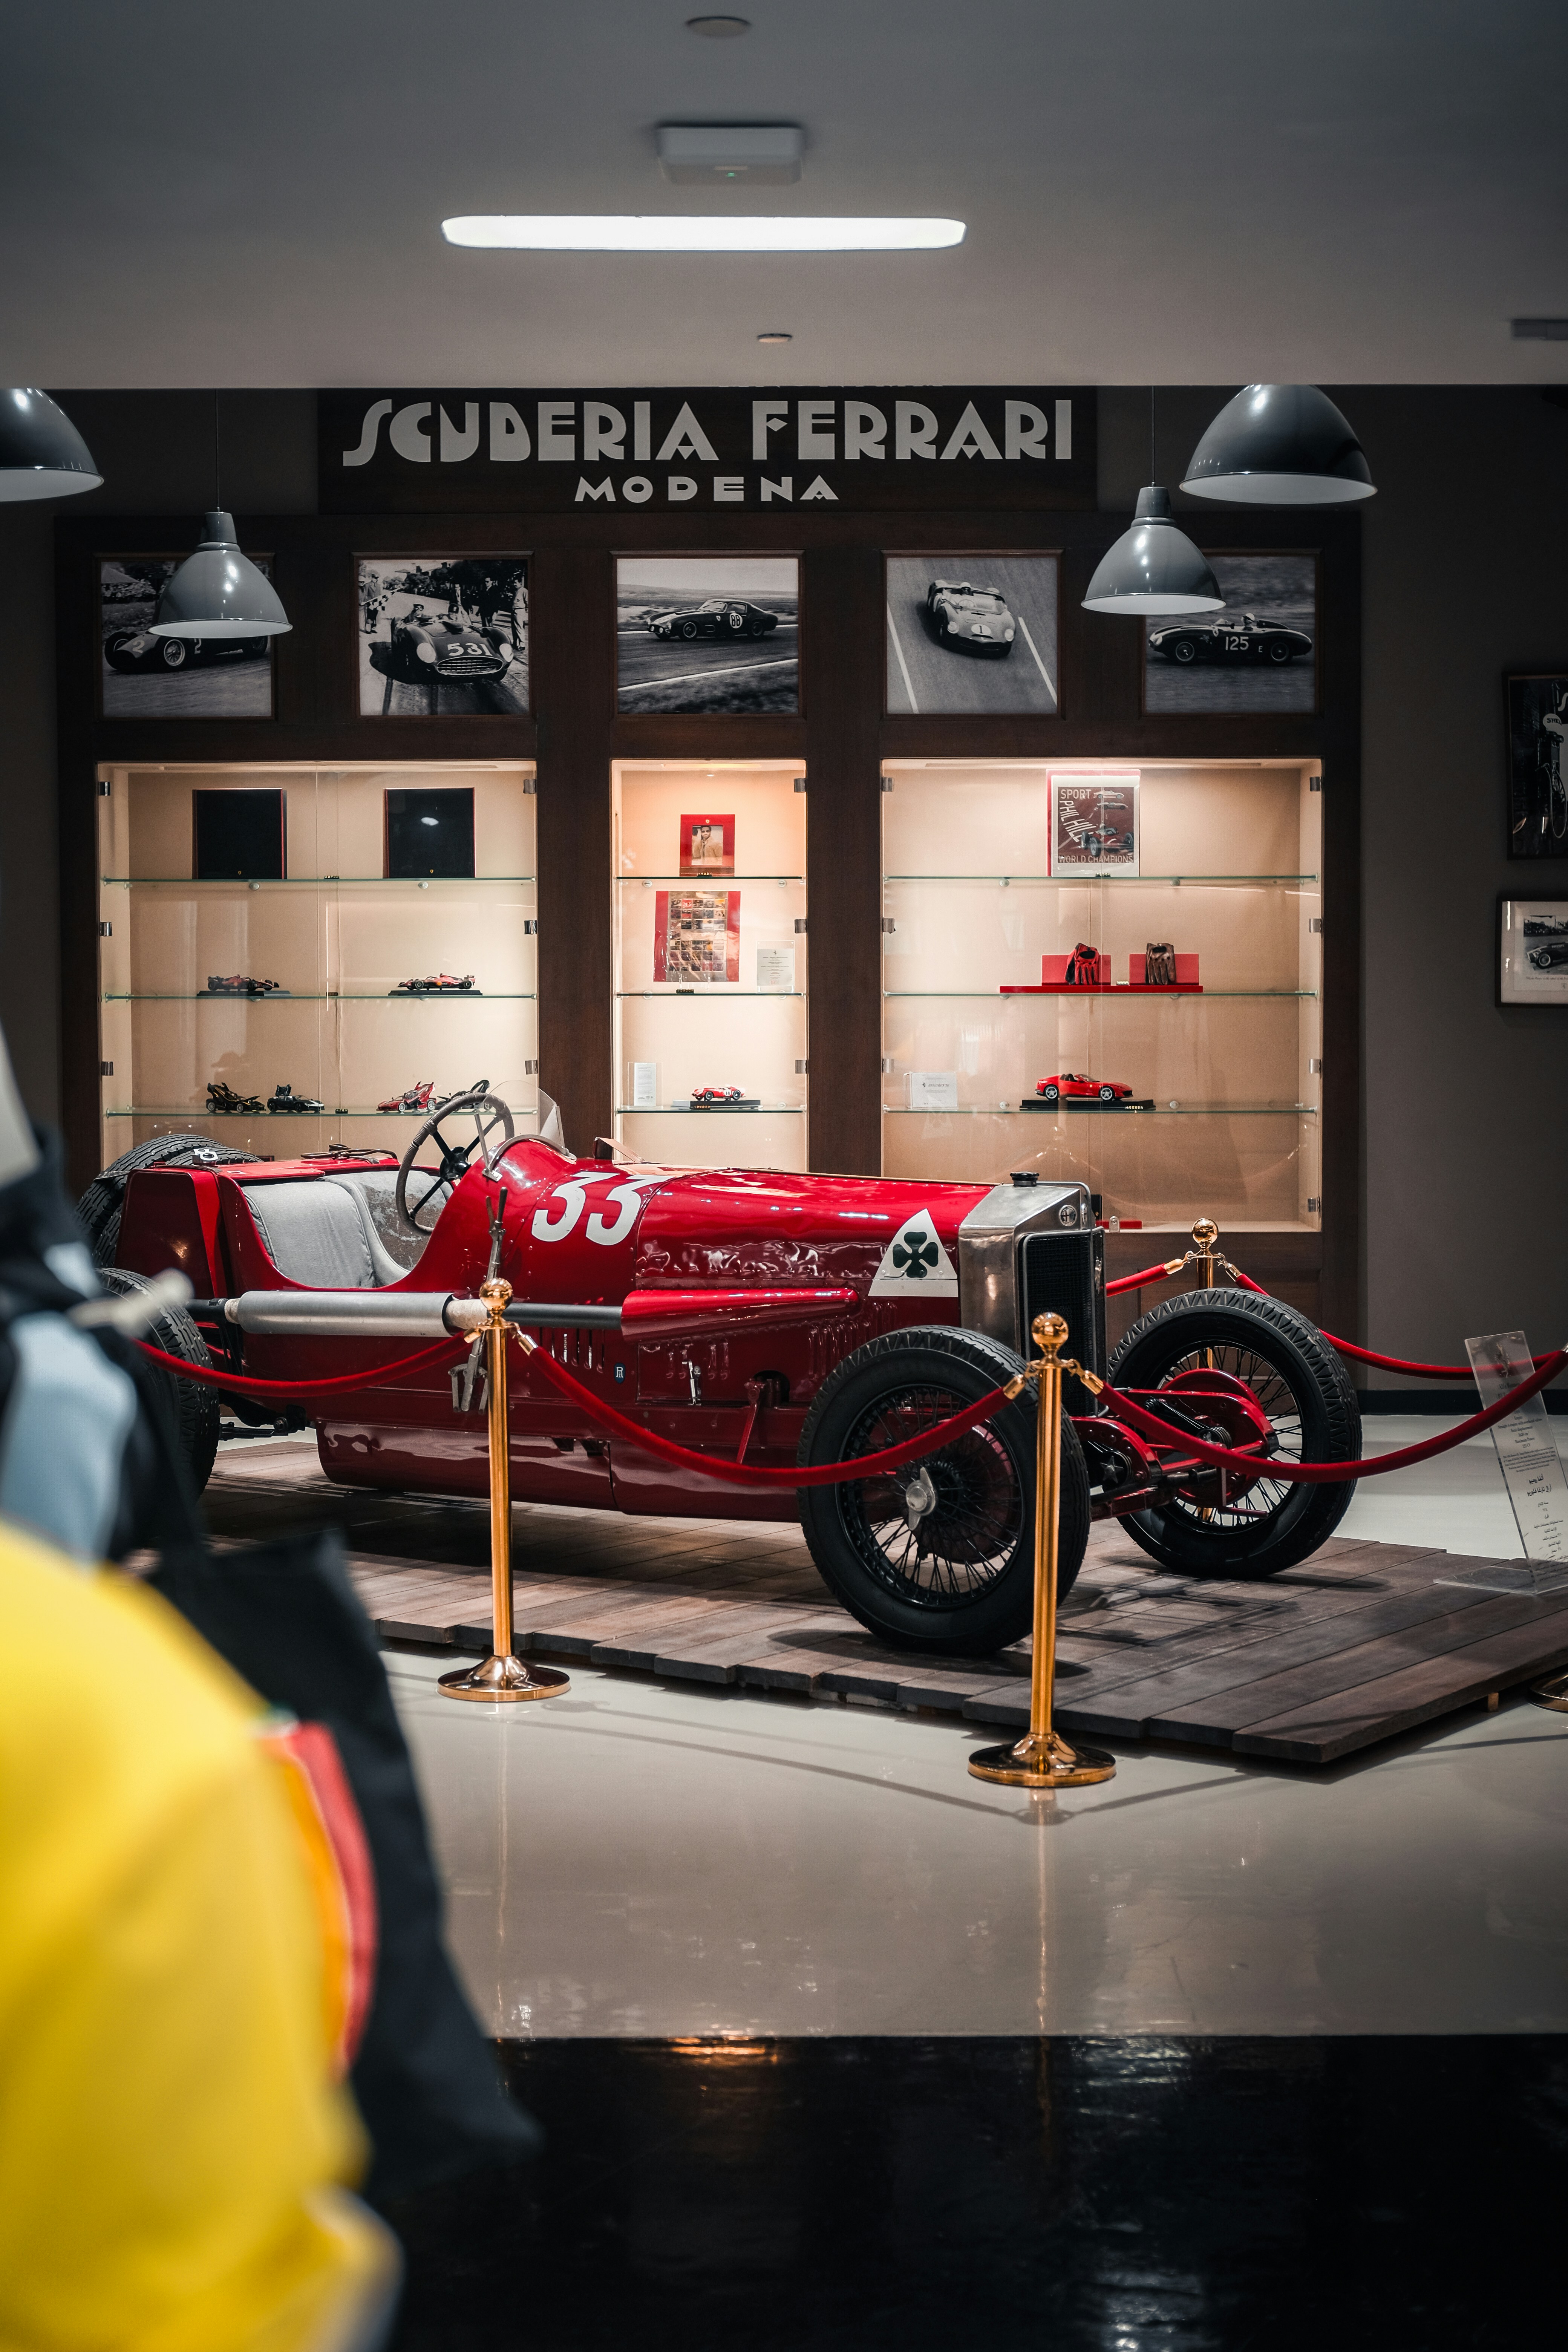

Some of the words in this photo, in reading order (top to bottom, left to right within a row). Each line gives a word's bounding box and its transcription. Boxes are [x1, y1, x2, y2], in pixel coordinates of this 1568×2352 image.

[343, 400, 719, 466] SCUDERIA
[753, 400, 1071, 459] FERRARI
[575, 475, 839, 503] MODENA
[730, 614, 741, 627] 88
[978, 625, 983, 634] 1
[132, 640, 145, 654] 2
[447, 642, 493, 657] 531
[1225, 636, 1250, 651] 125
[1060, 789, 1092, 799] SPORT
[1059, 800, 1080, 822] PHIL
[1063, 818, 1097, 842] HILL
[531, 1170, 675, 1246] 33
